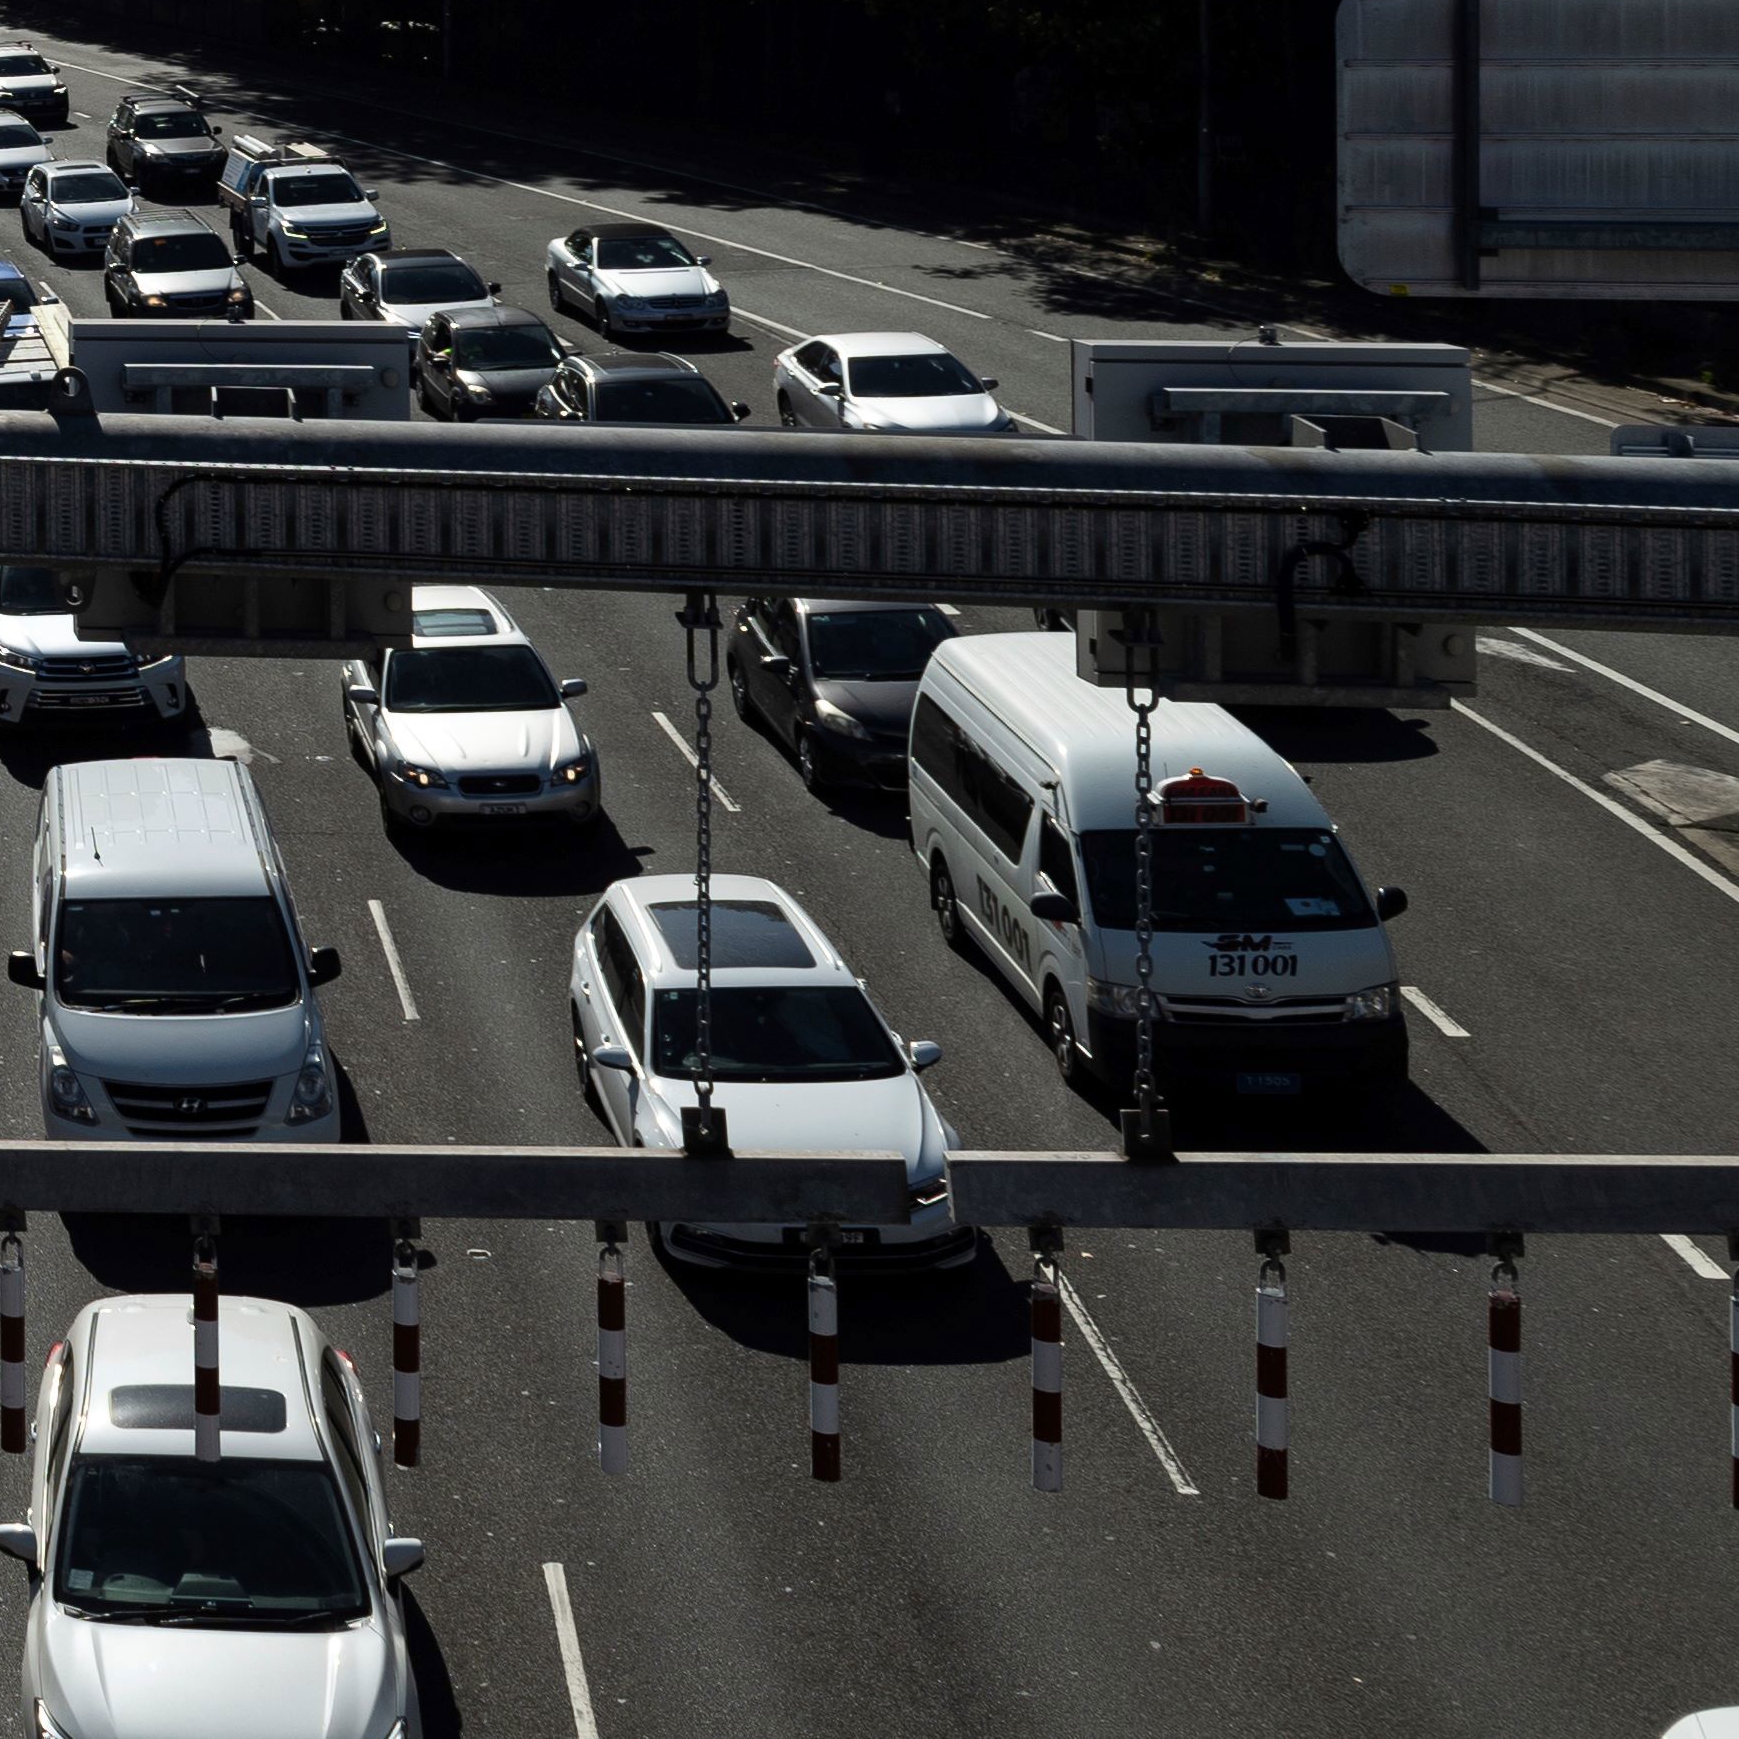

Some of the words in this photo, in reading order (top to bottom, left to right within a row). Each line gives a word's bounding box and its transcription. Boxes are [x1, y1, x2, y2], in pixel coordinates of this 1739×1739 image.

[976, 872, 1002, 936] 131
[1001, 904, 1033, 974] 001
[1209, 954, 1246, 977] 131
[1251, 954, 1298, 977] 001
